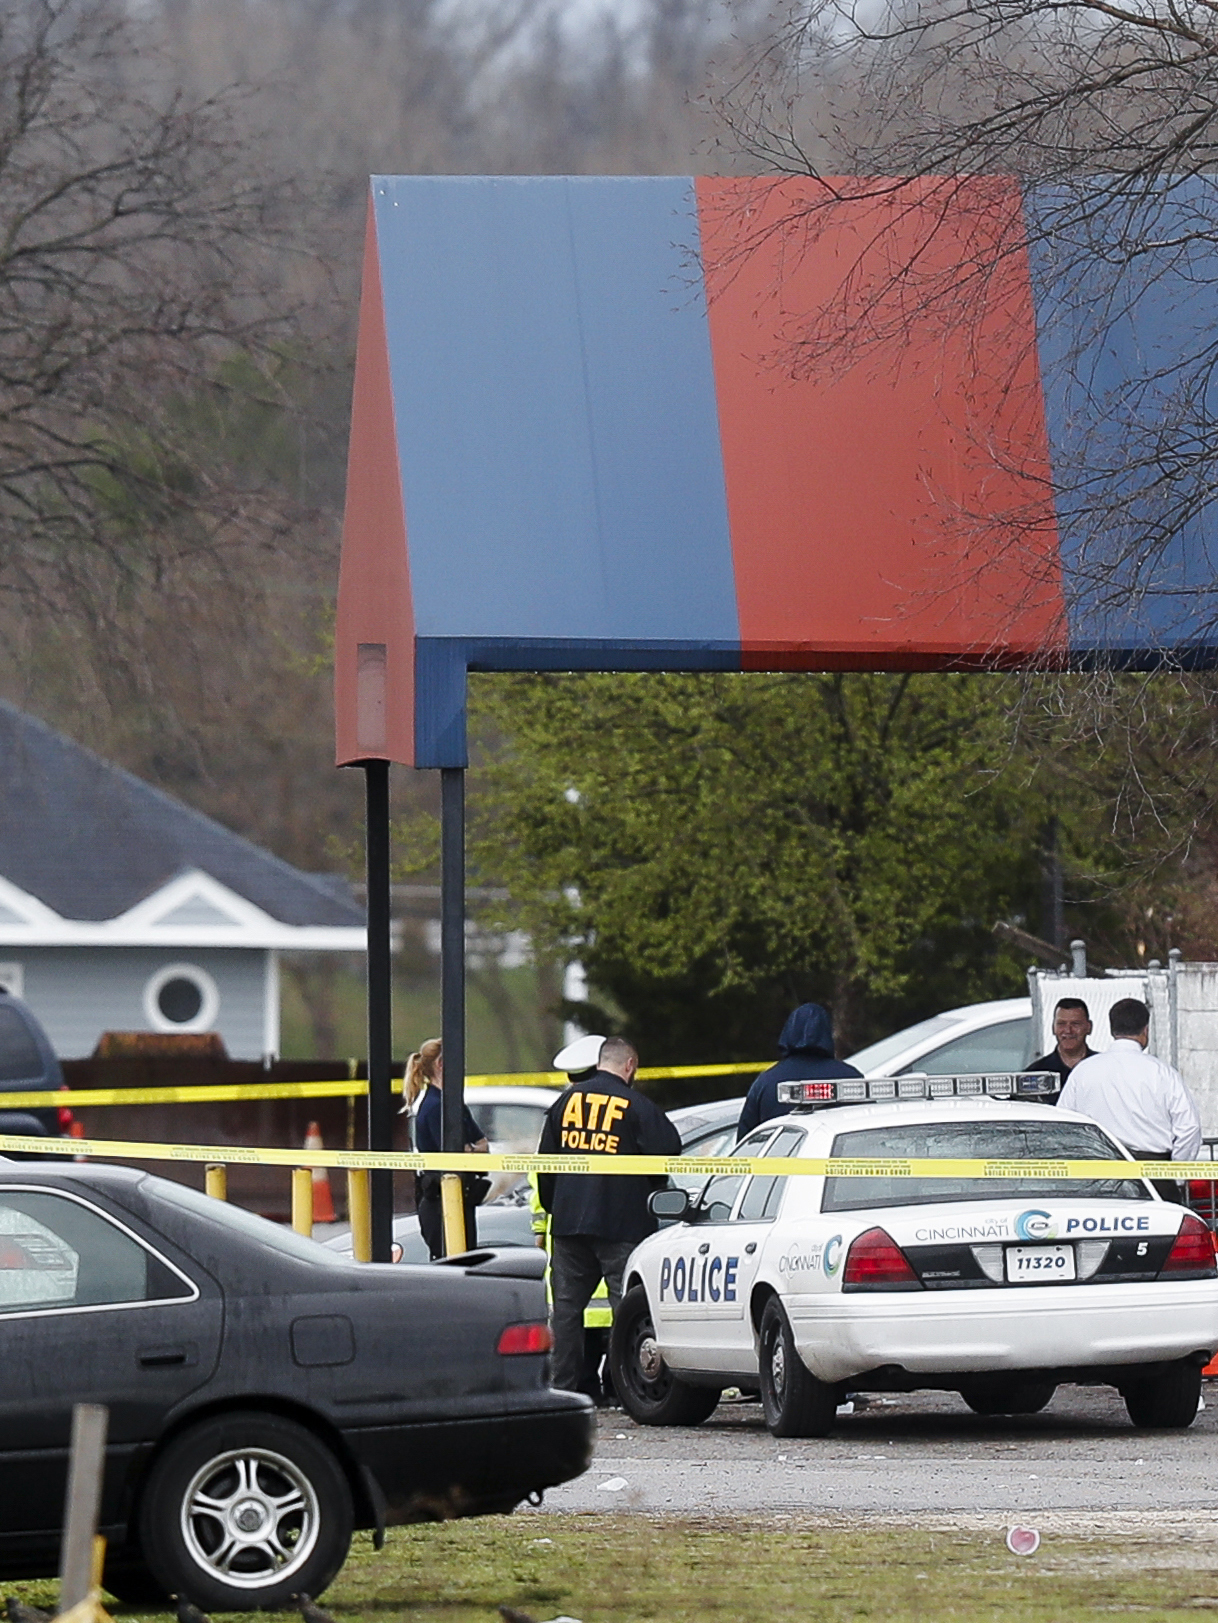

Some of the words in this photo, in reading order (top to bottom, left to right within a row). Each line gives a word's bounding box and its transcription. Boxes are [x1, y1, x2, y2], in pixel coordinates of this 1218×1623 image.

[562, 1092, 629, 1132] ATF
[561, 1130, 620, 1154] POLICE
[985, 1217, 998, 1226] city
[1000, 1216, 1008, 1224] of
[1066, 1216, 1150, 1234] POLICE
[915, 1225, 1009, 1241] CINCINNATI
[1136, 1241, 1149, 1256] 5
[779, 1254, 821, 1273] CINCINNATI
[1016, 1256, 1066, 1270] 11320
[659, 1255, 740, 1302] POLICE
